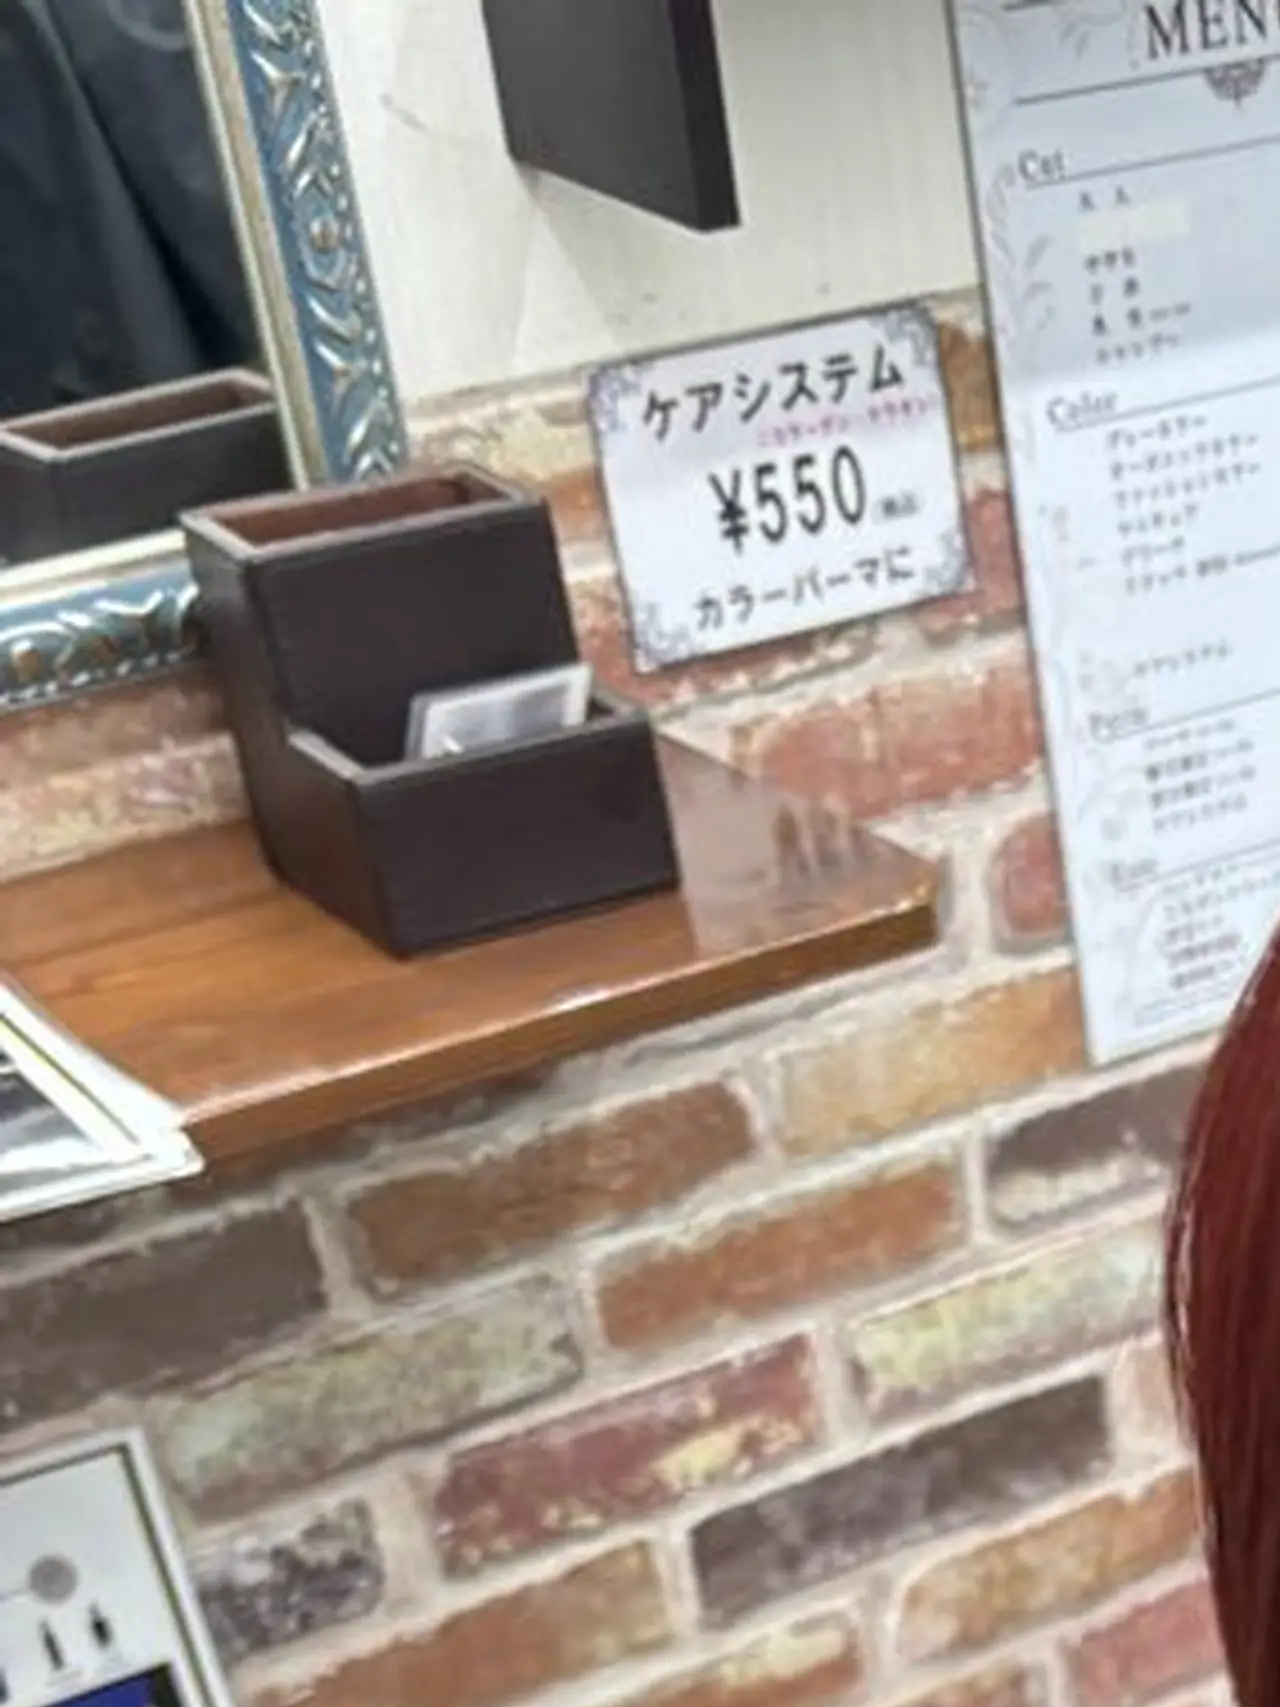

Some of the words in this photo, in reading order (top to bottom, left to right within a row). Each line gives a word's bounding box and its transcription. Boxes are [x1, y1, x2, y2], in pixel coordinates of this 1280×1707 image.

[643, 344, 903, 440] ケアシステム
[709, 445, 866, 553] ¥550
